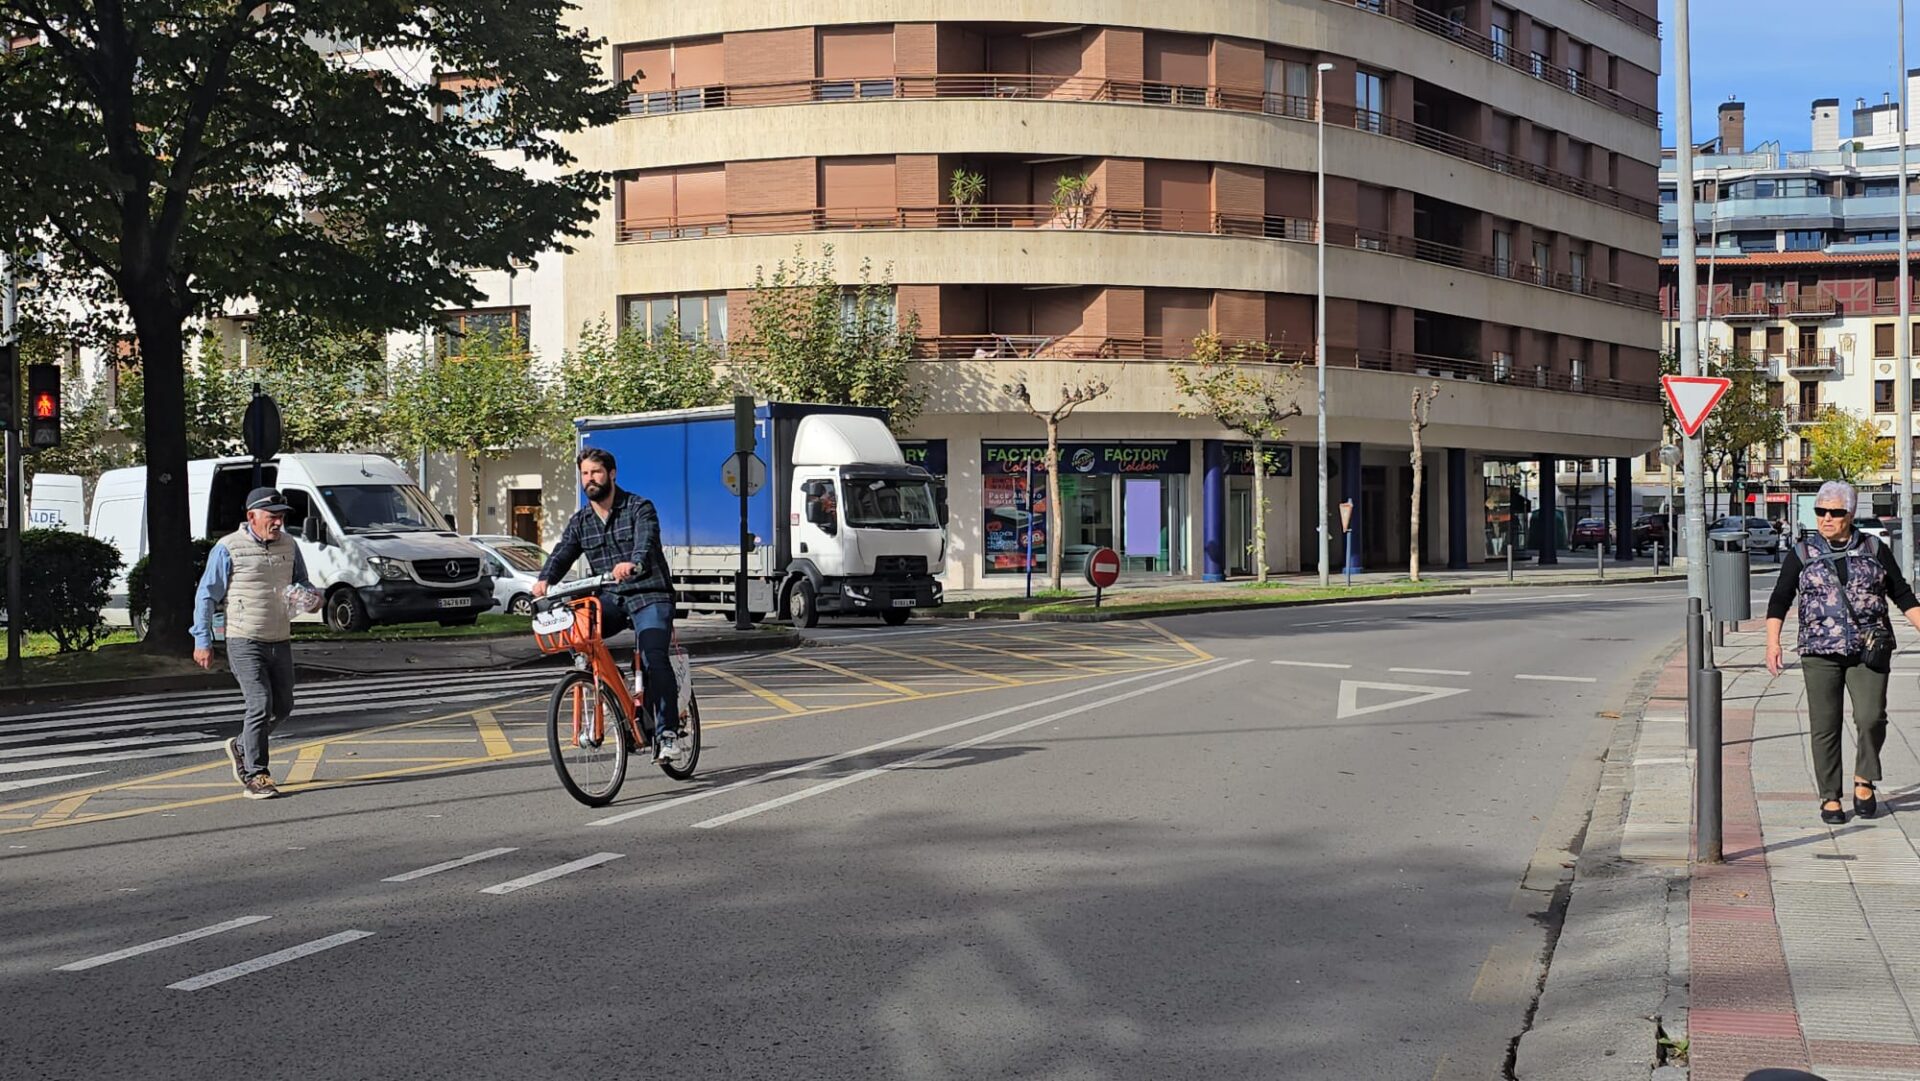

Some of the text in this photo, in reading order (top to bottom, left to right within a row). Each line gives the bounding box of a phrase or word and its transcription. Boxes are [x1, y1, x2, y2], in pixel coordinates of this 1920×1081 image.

[987, 448, 1065, 461] FACTOY
[1104, 448, 1168, 461] FACTORY
[1118, 459, 1159, 472] Colchon
